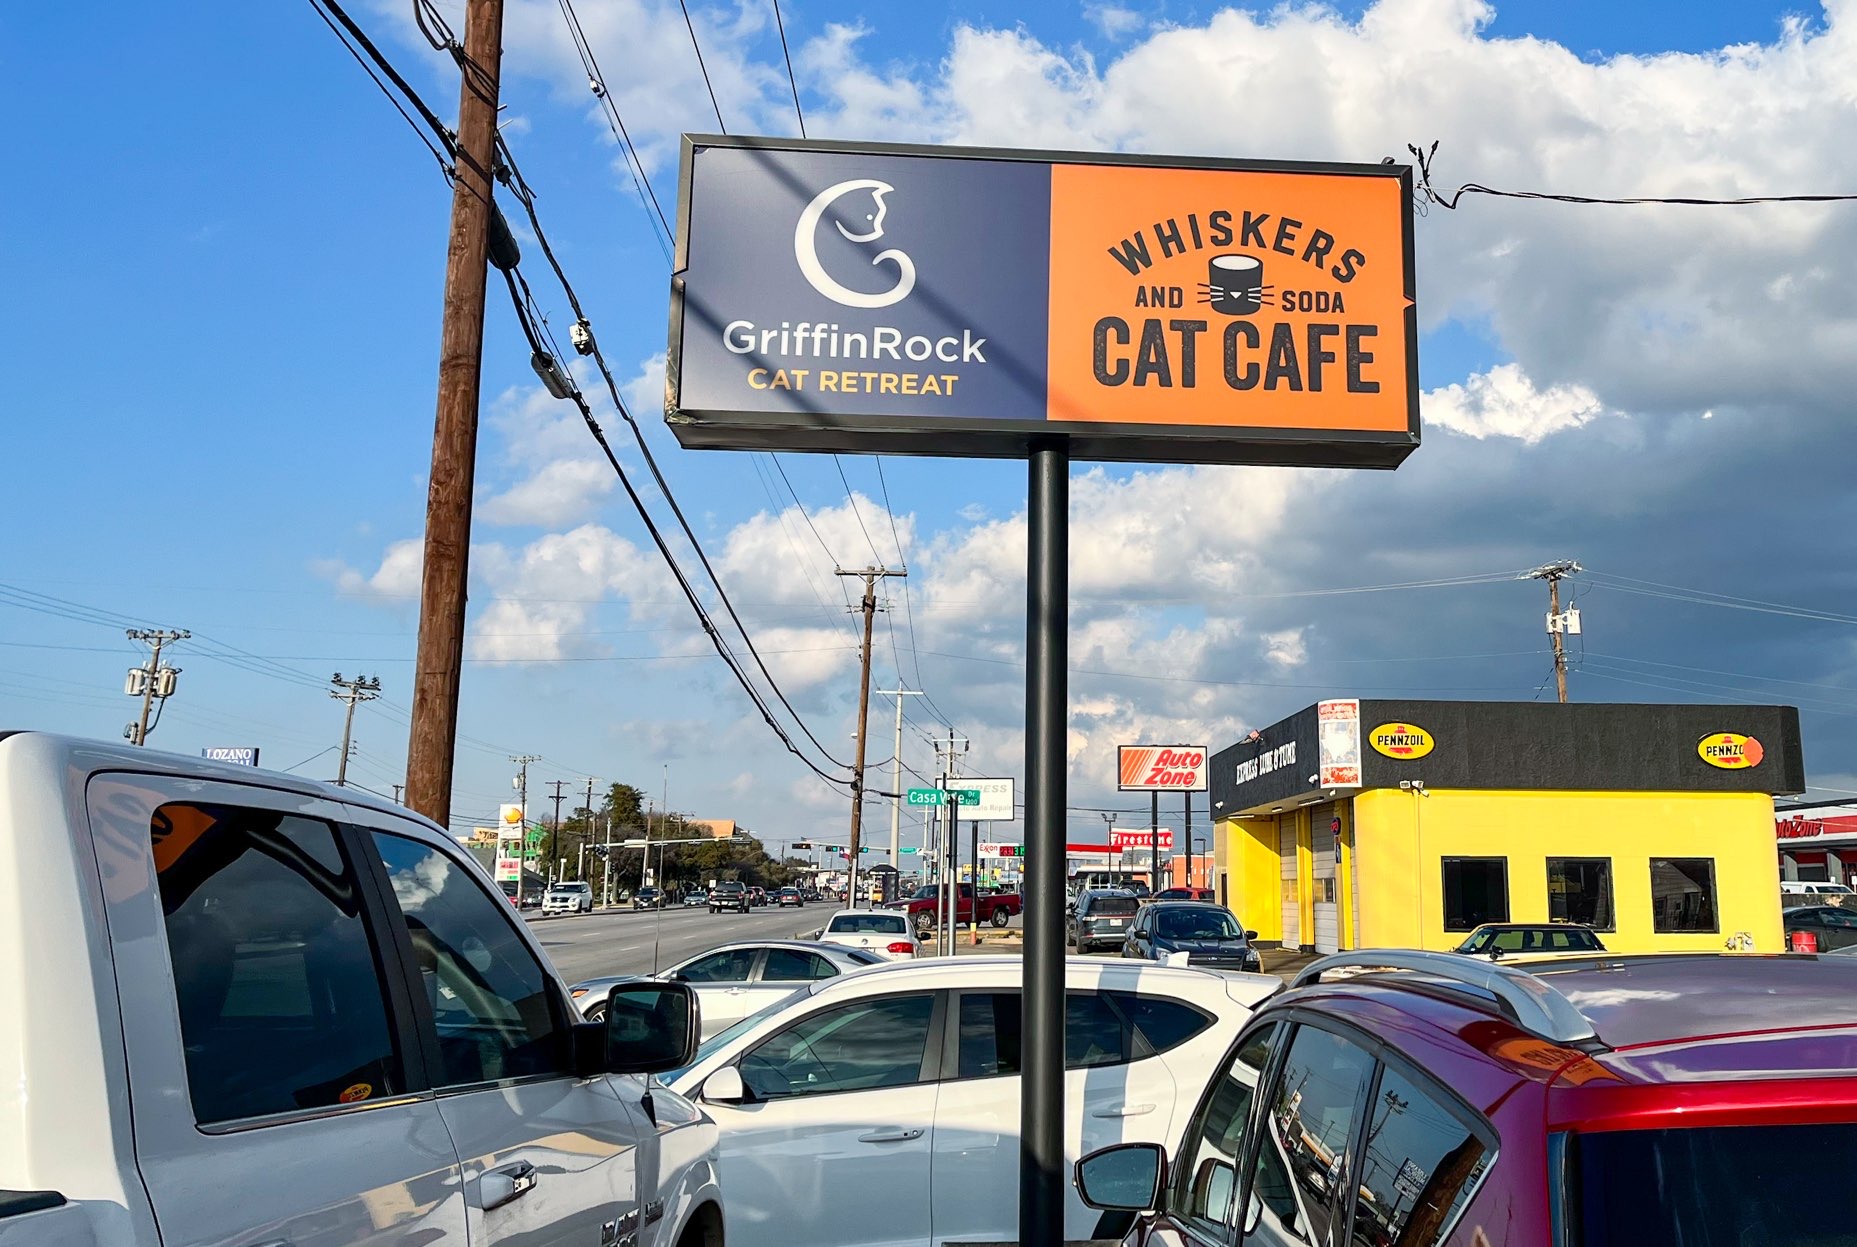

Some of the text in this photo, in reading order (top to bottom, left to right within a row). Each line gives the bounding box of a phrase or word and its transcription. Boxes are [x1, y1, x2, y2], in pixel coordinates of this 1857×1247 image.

[1107, 210, 1366, 284] WHISKERS
[1135, 286, 1345, 313] AND SODA
[723, 320, 987, 363] GriffinRock
[1093, 316, 1380, 393] CAT CAFE
[747, 368, 959, 395] CAT RETREAT
[1377, 735, 1425, 746] PENNZOIL
[206, 748, 252, 760] LOZANO
[1154, 749, 1203, 768] Auto
[1706, 744, 1744, 757] PENNZO
[1144, 768, 1197, 786] Zone
[909, 791, 937, 804] Casa
[979, 844, 998, 854] Exxon
